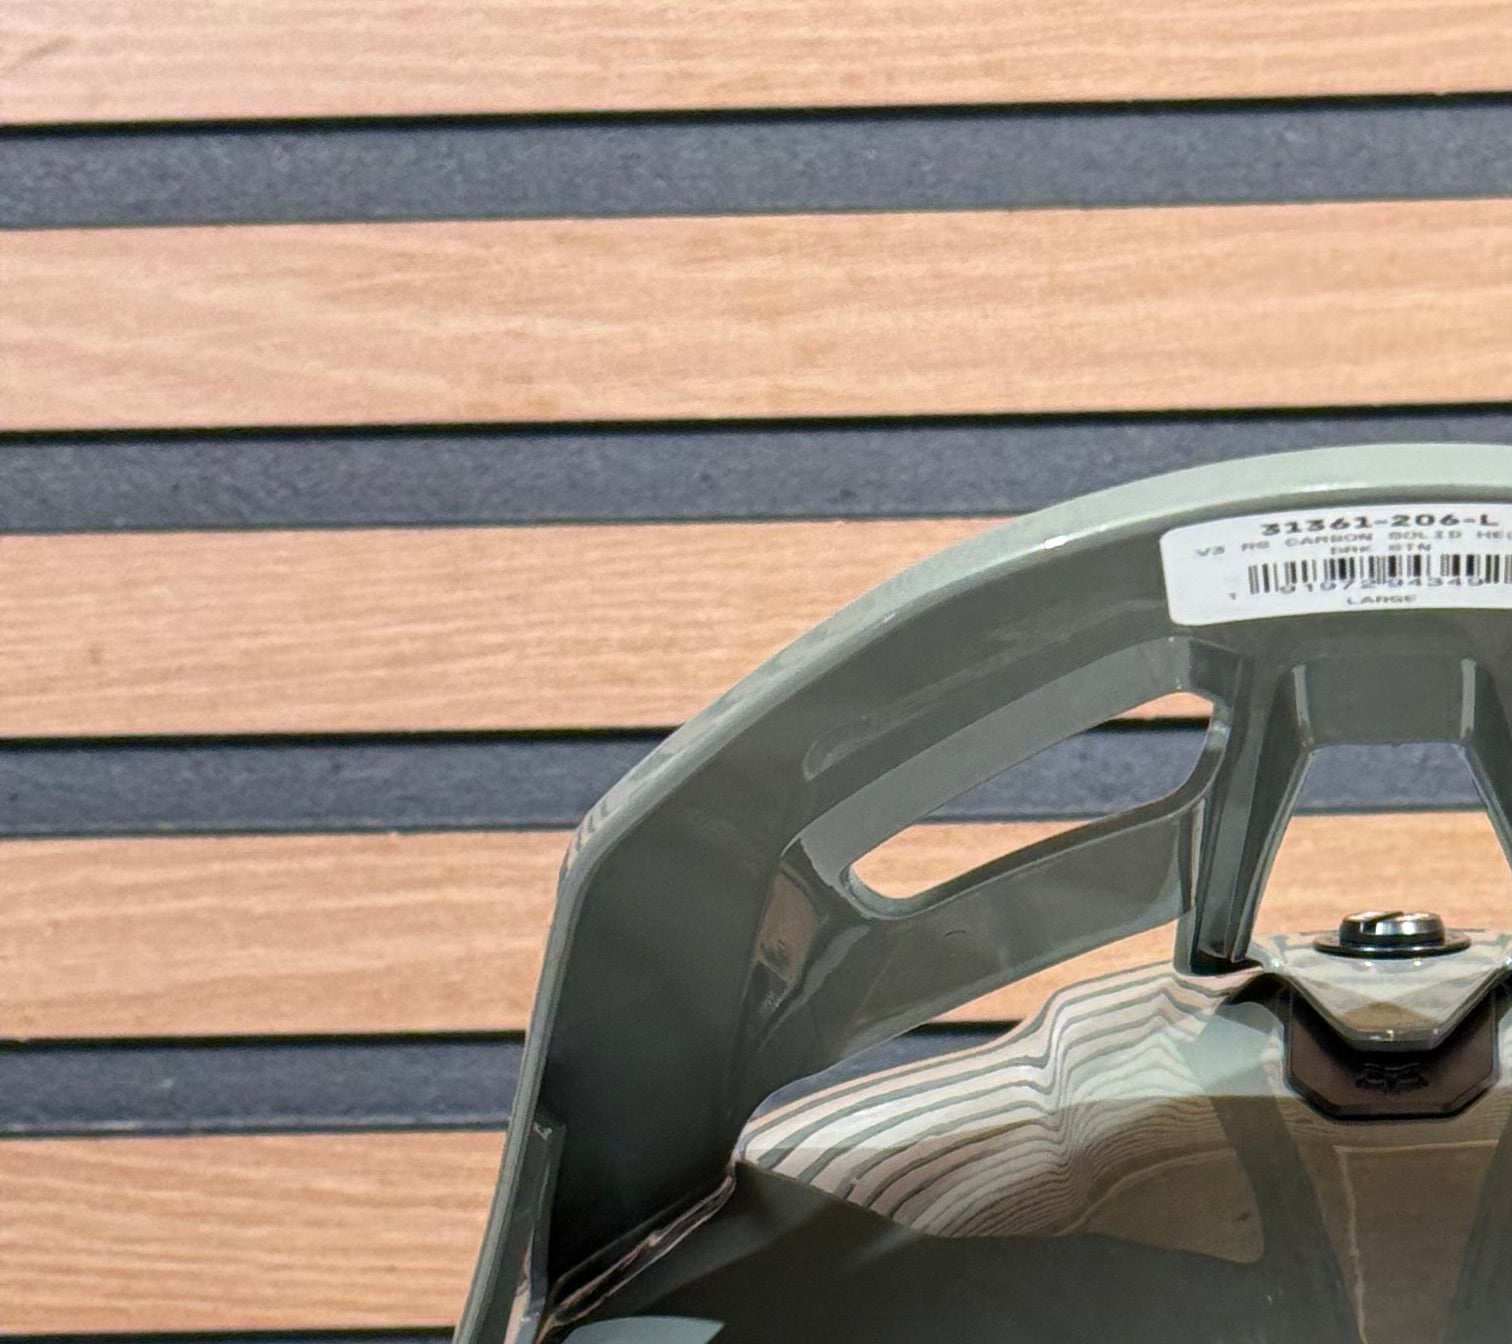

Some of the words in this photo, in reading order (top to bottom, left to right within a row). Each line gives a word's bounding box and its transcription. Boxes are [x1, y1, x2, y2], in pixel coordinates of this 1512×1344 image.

[1259, 513, 1501, 536] 31361-206-L
[1284, 531, 1373, 549] CARBON
[1347, 594, 1418, 606] LARGE
